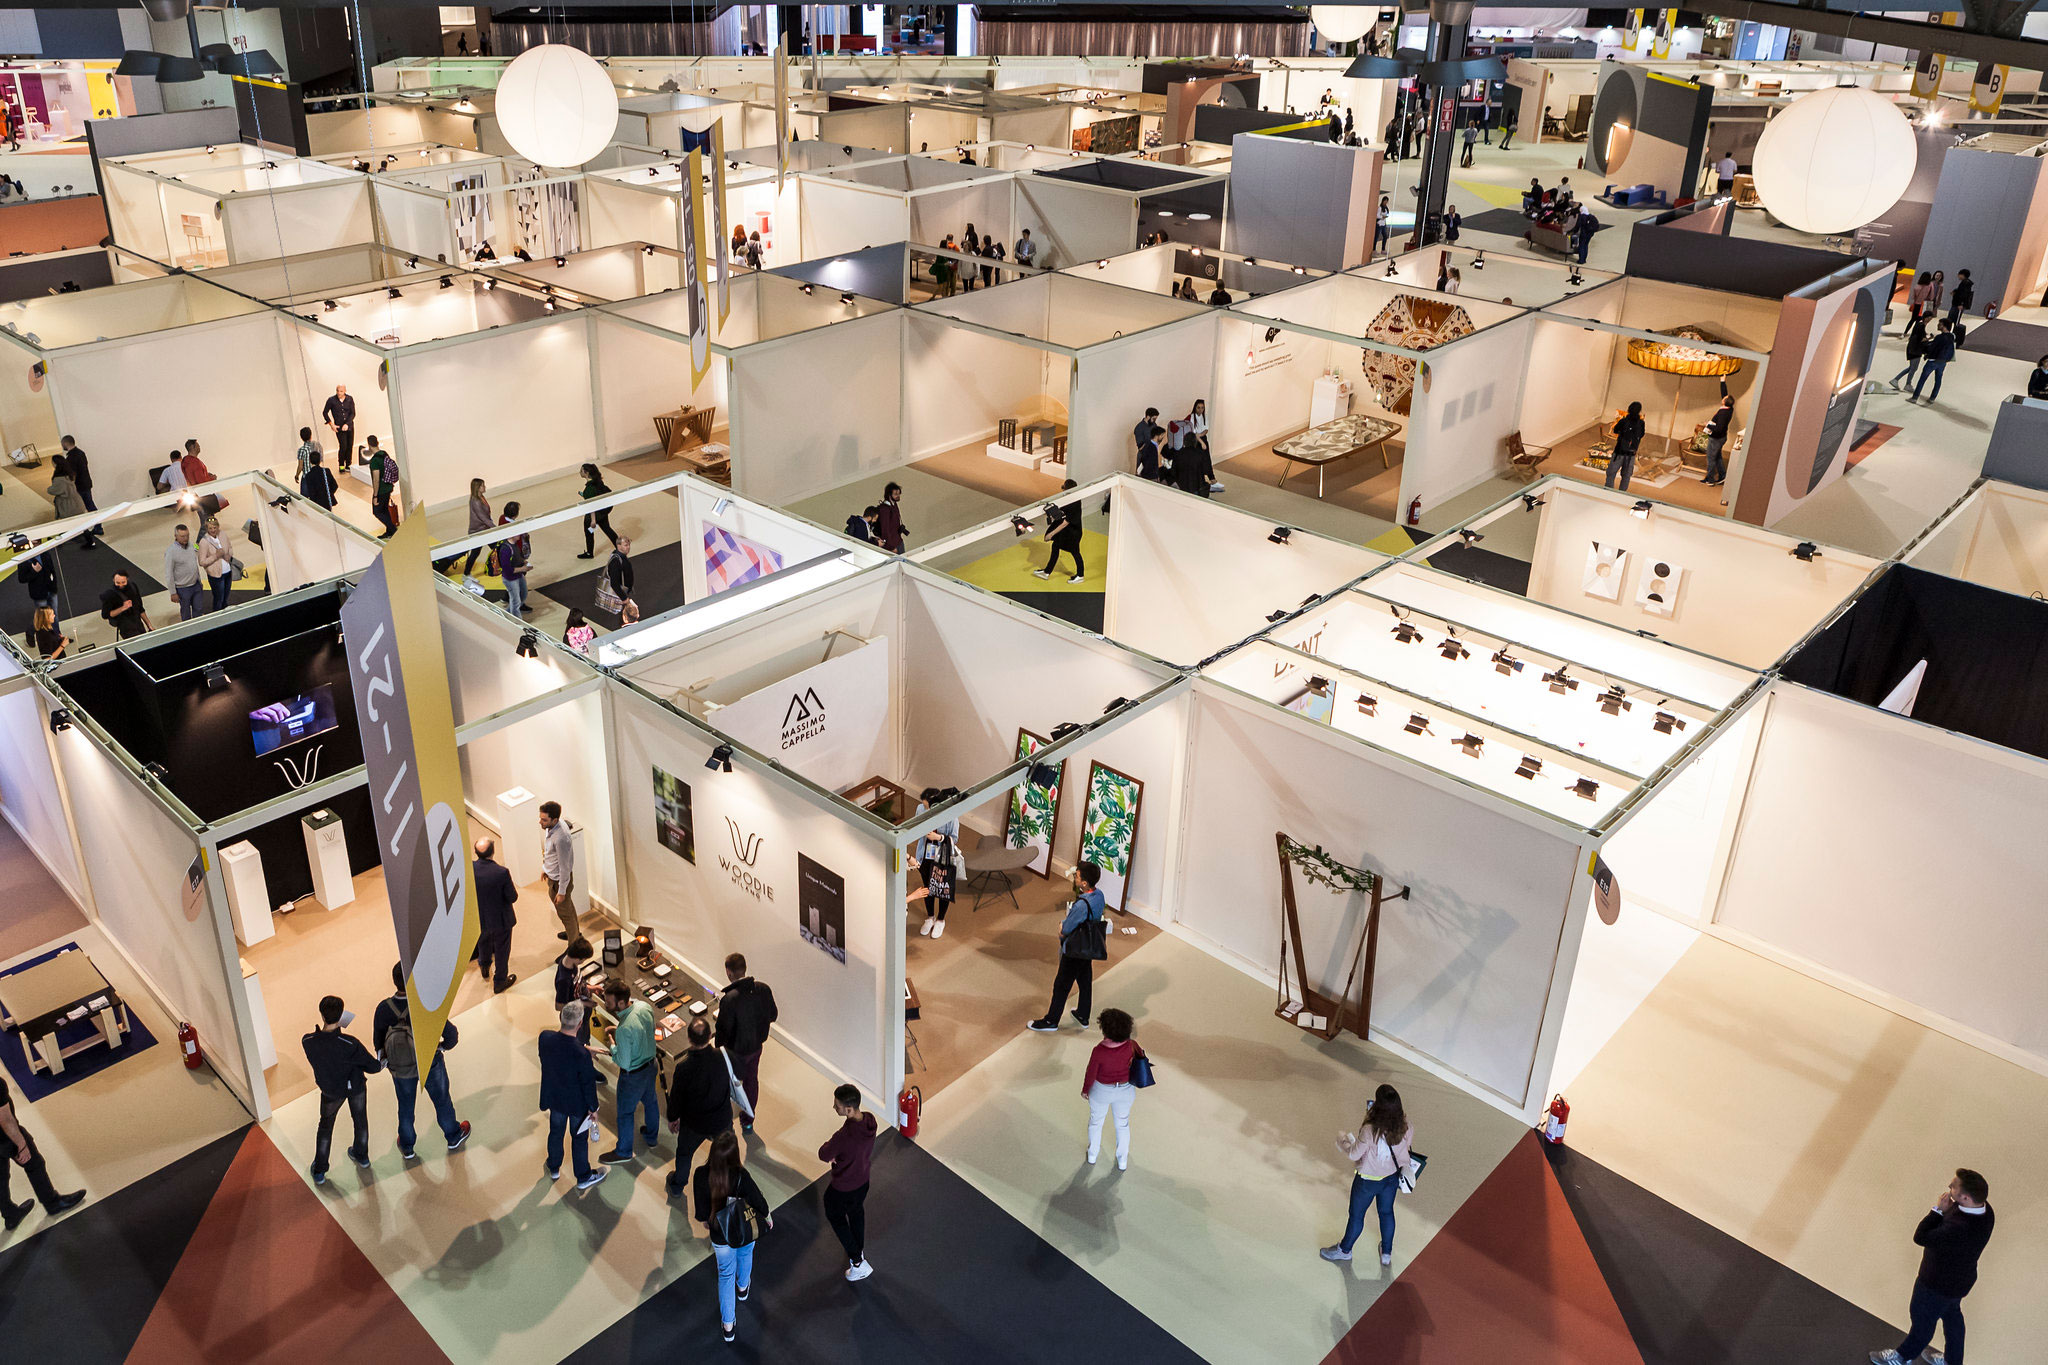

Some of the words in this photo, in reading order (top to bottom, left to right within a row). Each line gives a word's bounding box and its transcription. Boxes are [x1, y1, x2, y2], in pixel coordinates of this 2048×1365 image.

[1631, 23, 1637, 37] A
[1663, 30, 1669, 44] A
[1929, 63, 1938, 81] B
[1990, 75, 2000, 93] B
[782, 713, 826, 741] MASSIMO
[782, 724, 826, 750] CAPPELLA
[437, 818, 460, 916] E
[718, 854, 775, 902] WOODIE
[731, 876, 762, 901] MILANO
